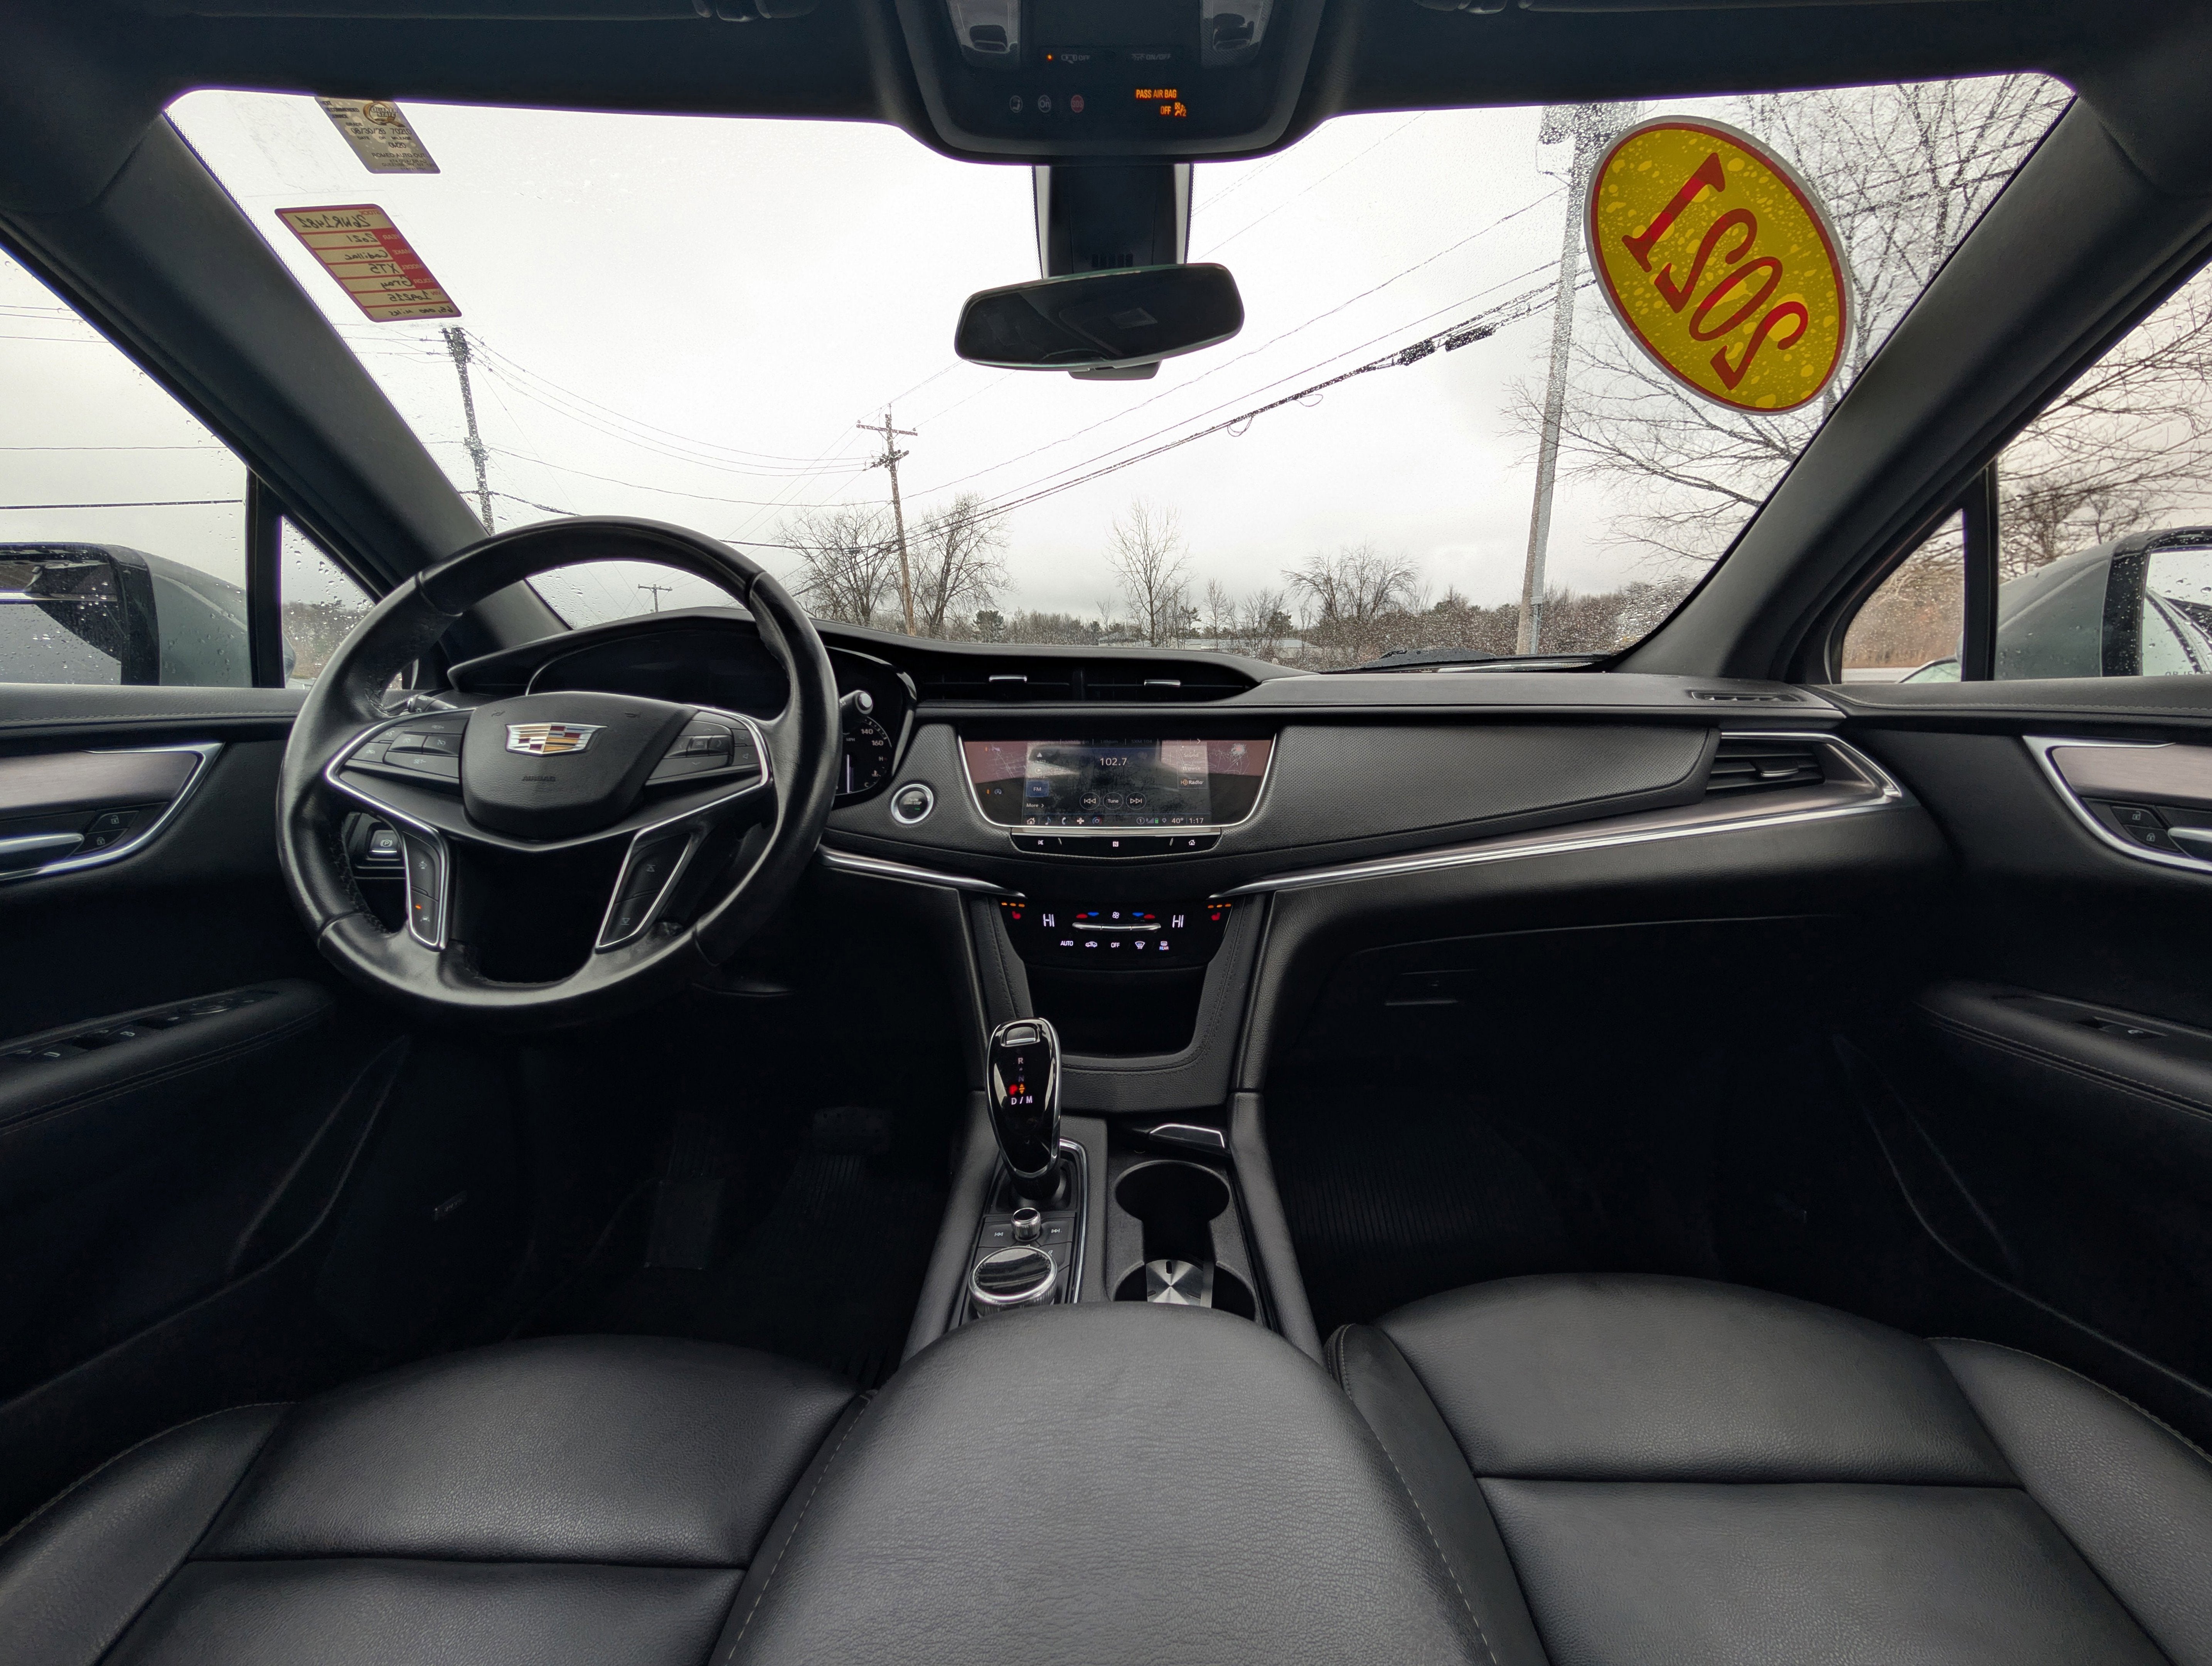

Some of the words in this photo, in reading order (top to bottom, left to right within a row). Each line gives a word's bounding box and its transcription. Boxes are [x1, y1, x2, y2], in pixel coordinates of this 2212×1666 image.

[1135, 89, 1152, 99] PASS
[1153, 89, 1163, 99] AIR
[1164, 89, 1177, 99] BAG
[1160, 106, 1171, 115] OFF
[1100, 757, 1127, 766] 102.7
[1043, 914, 1055, 927] HI
[1172, 915, 1184, 928] HI
